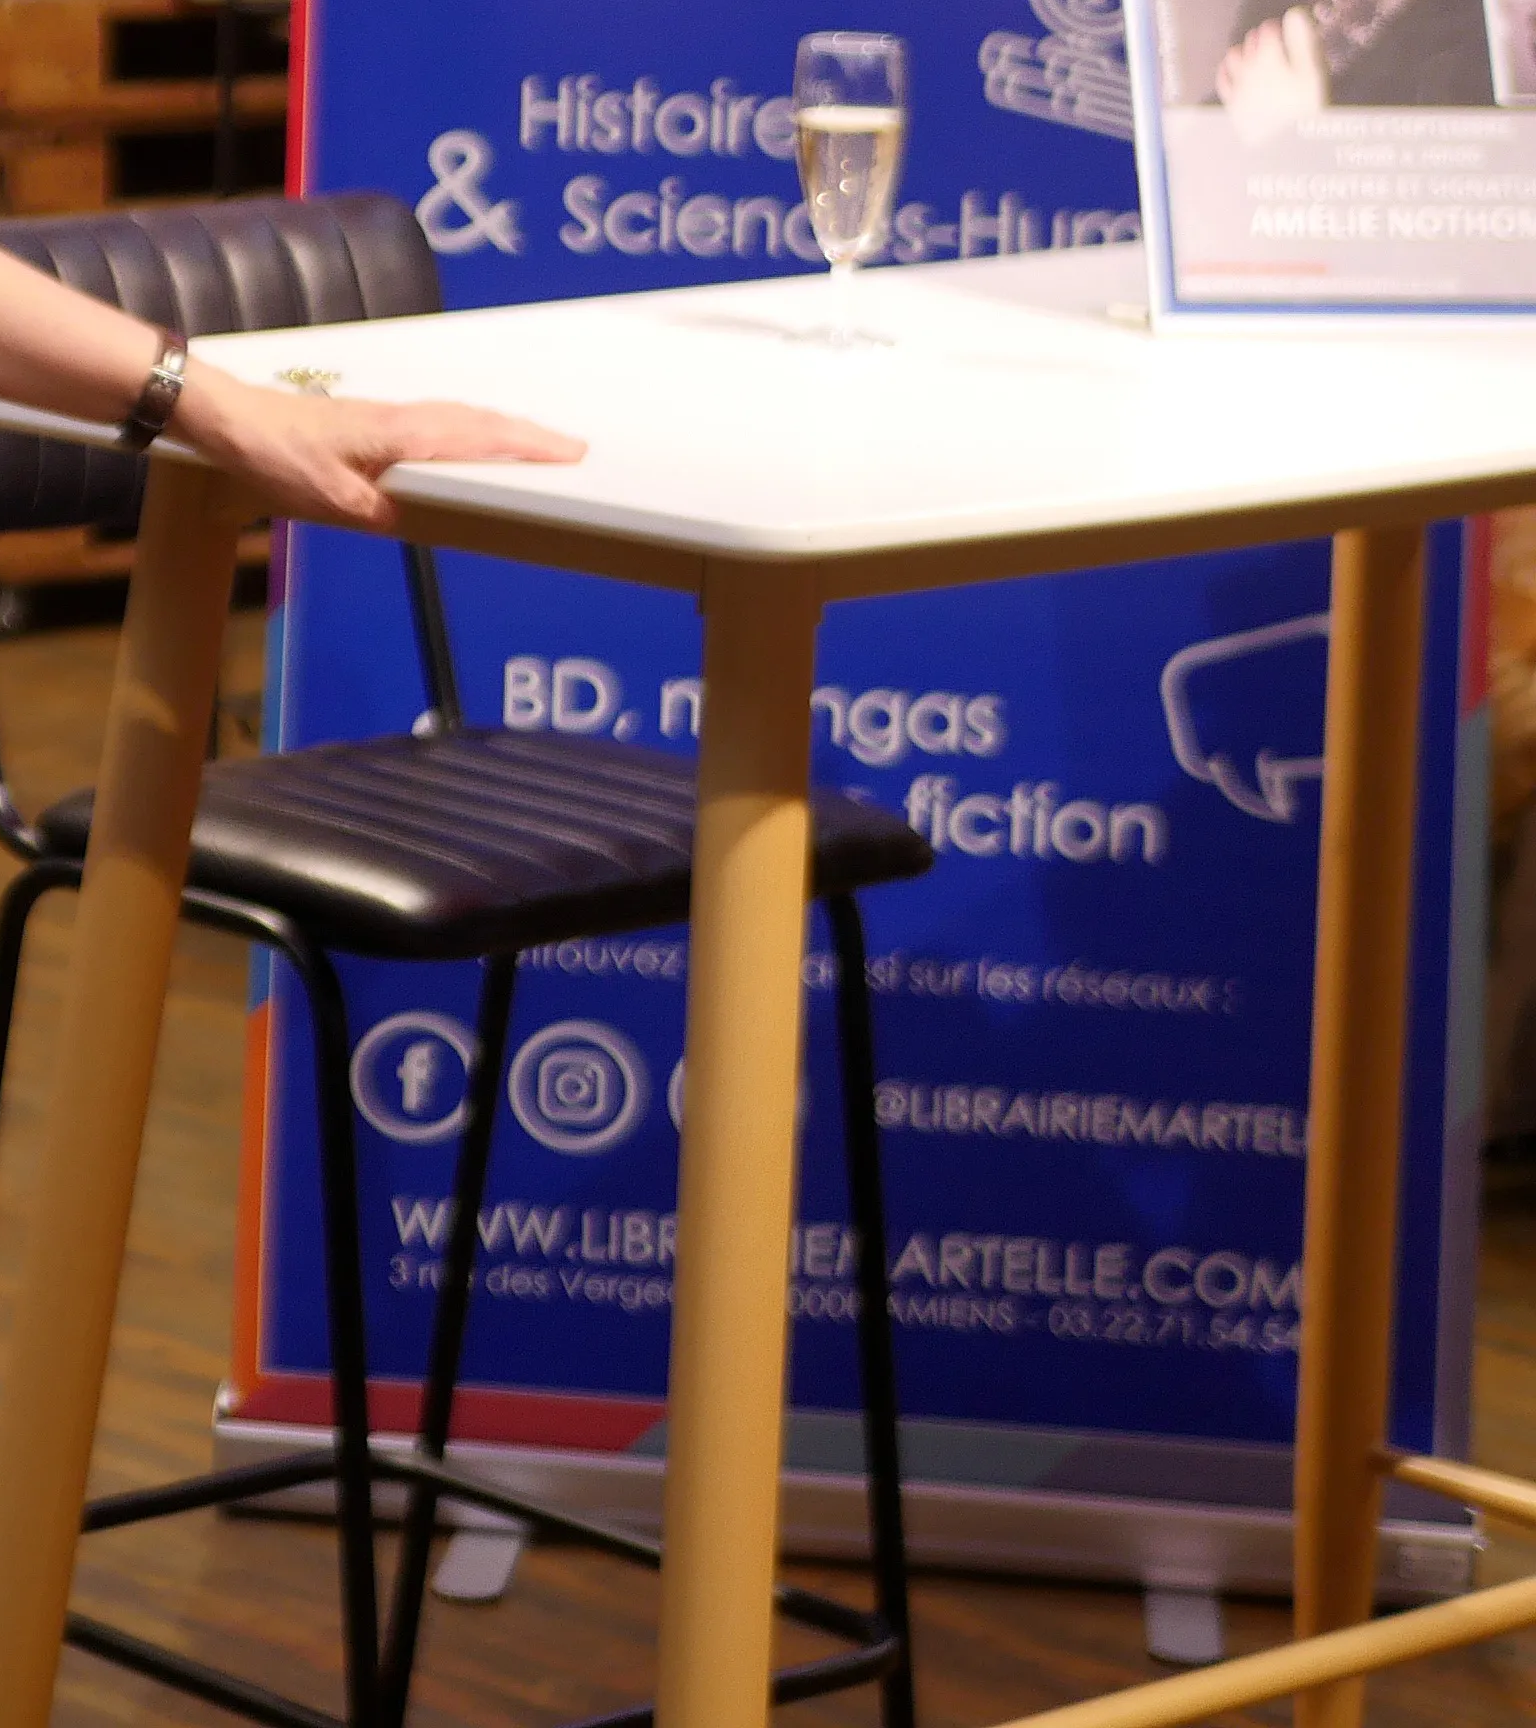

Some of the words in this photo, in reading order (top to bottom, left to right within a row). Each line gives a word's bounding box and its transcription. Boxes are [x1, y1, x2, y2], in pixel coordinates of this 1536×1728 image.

[414, 129, 522, 255] &
[503, 656, 641, 742] BD,
[659, 678, 1007, 767] mngas
[485, 1263, 550, 1300] des
